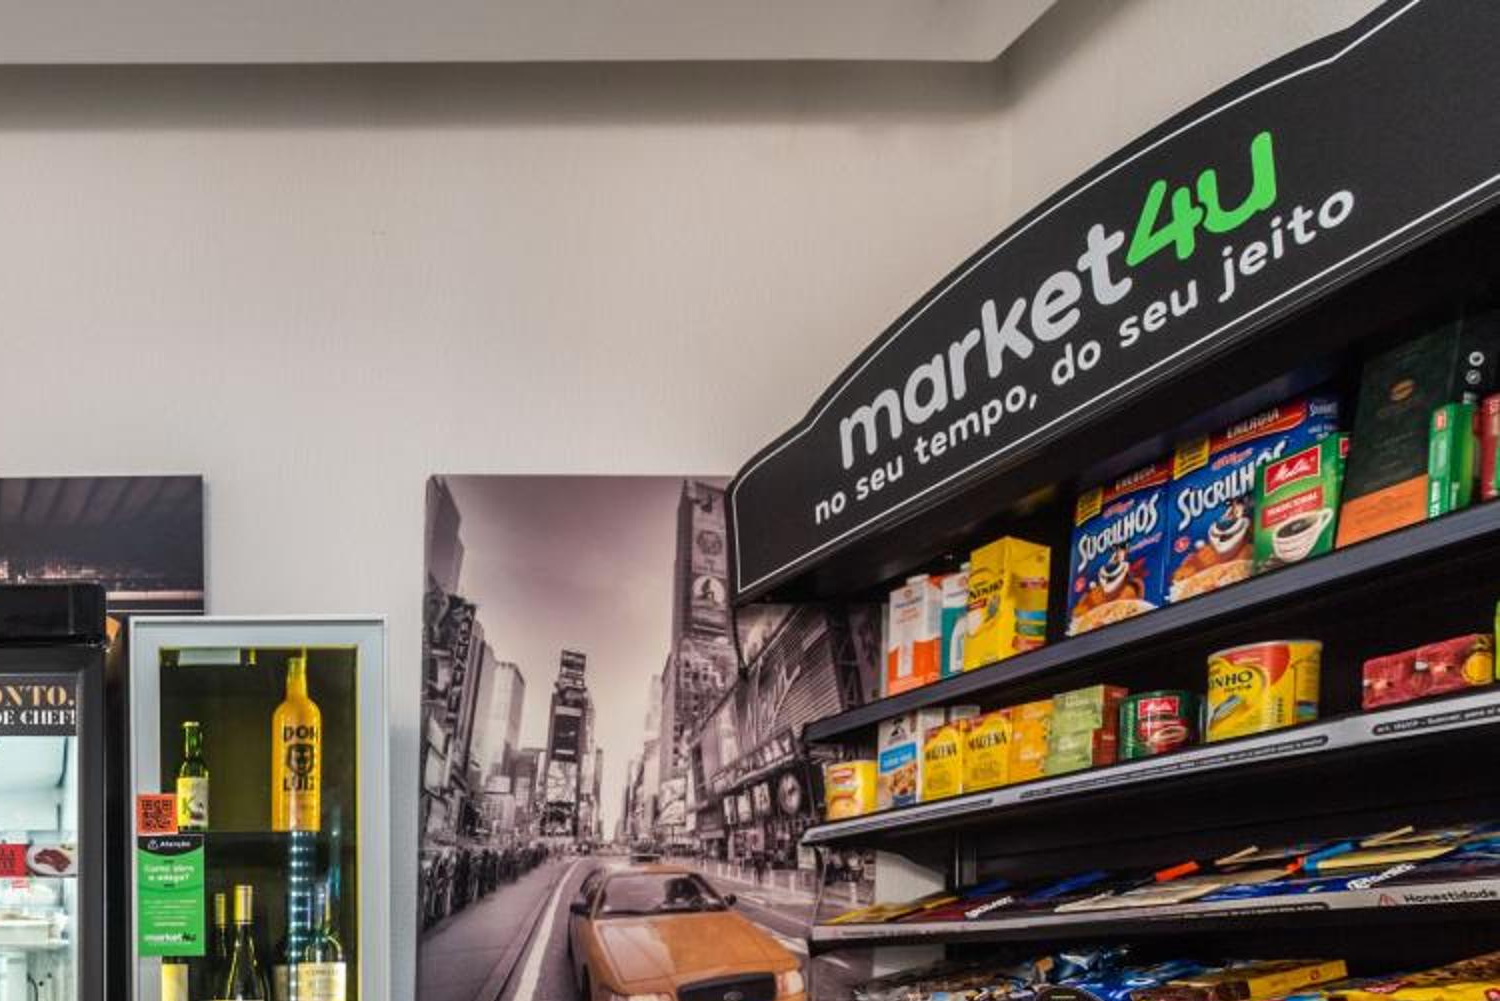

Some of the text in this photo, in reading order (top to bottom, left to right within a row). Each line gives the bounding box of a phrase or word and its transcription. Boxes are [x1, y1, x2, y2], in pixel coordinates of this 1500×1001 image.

[815, 189, 1355, 525] no seu tempo, do seu jeito
[839, 131, 1277, 469] market4u
[1077, 491, 1159, 573] SUCRILHOS
[20, 708, 76, 726] CHEF!
